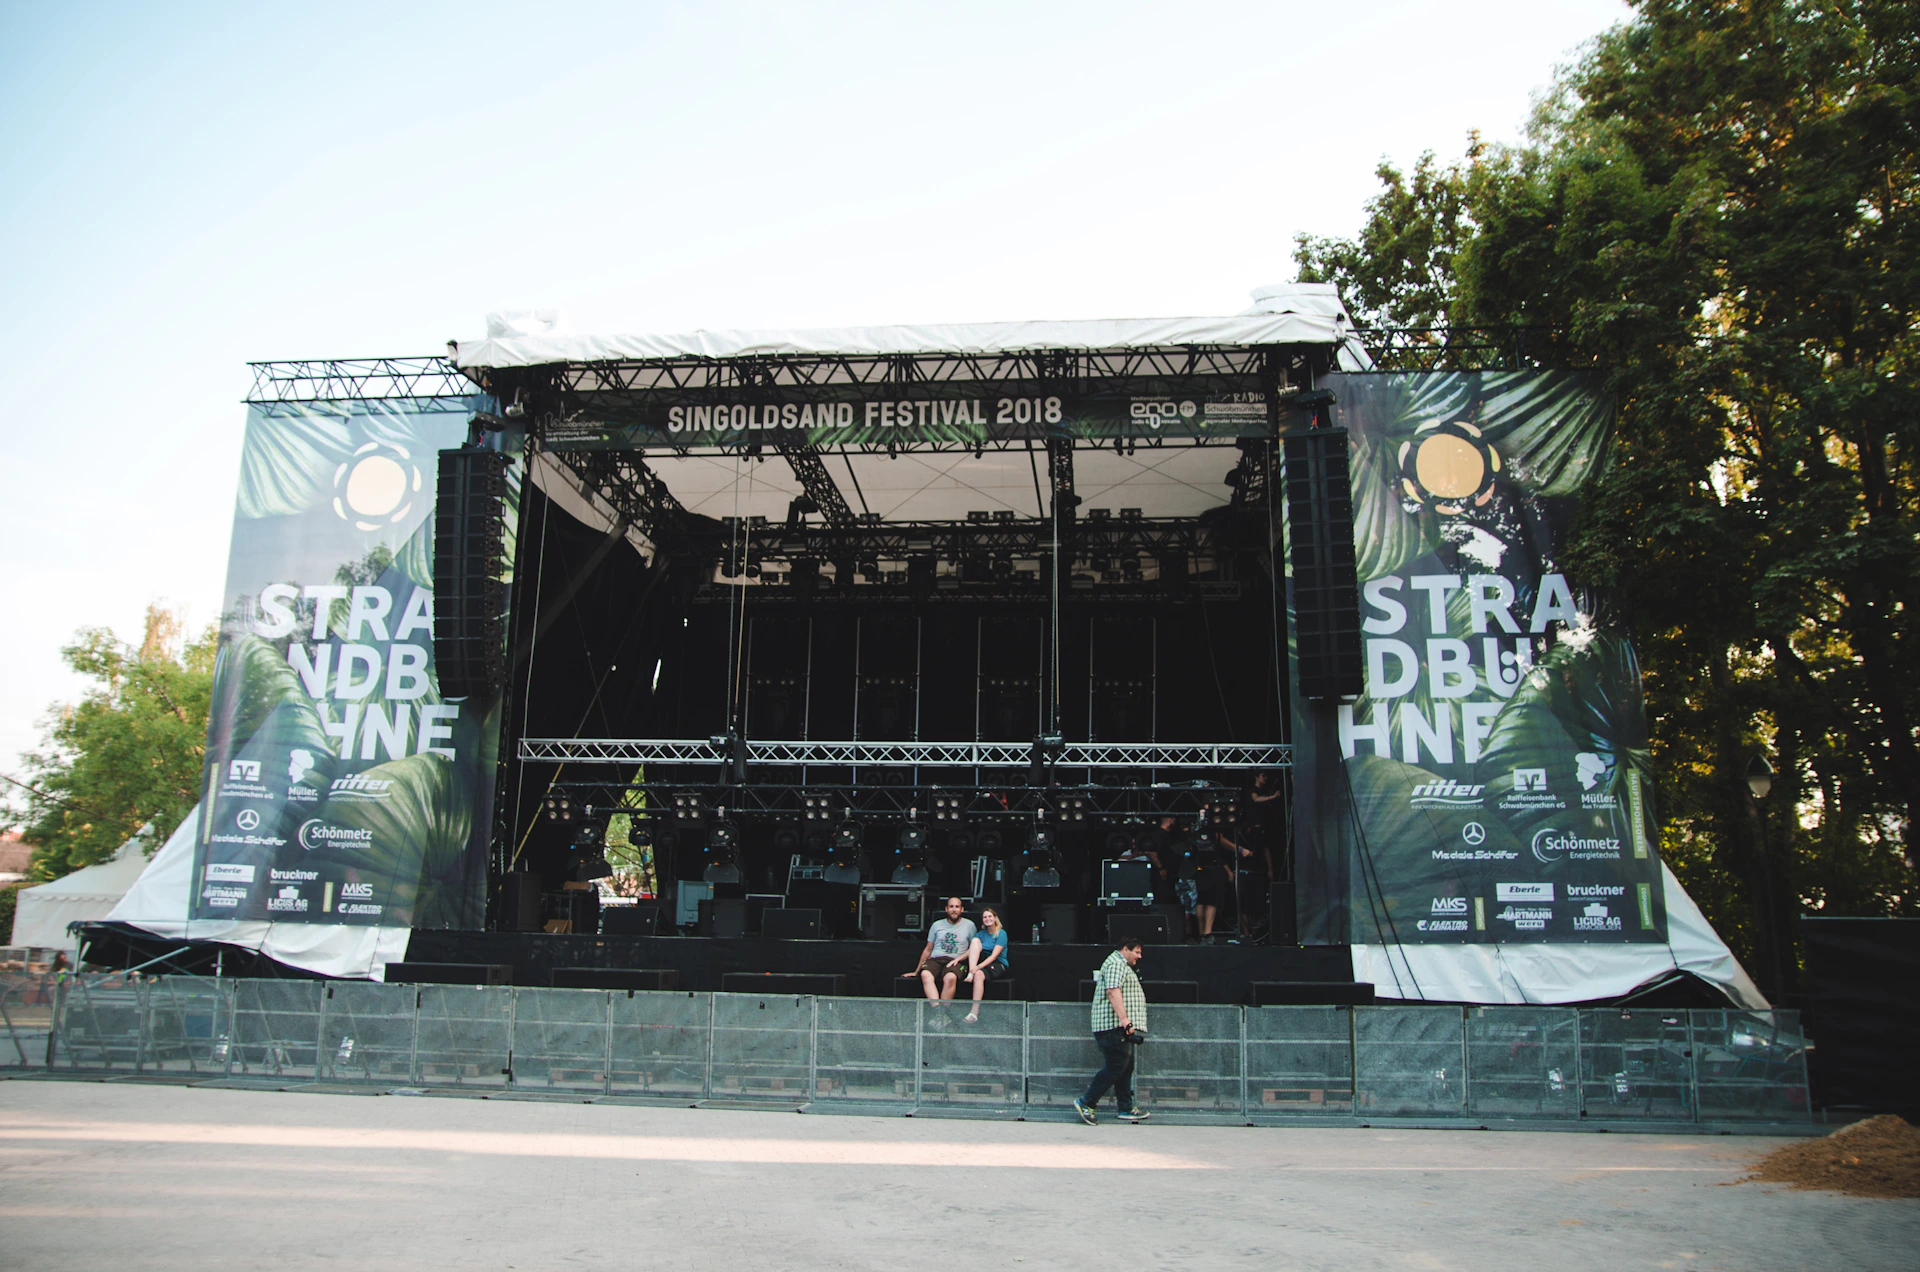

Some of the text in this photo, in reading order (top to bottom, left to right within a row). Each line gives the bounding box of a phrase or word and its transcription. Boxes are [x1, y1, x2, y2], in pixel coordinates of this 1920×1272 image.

[1233, 392, 1265, 403] RADIO
[668, 397, 1062, 432] SINGOLDSAND FESTIVAL 2018
[1361, 573, 1583, 634] STRA
[253, 583, 434, 641] STRA
[287, 643, 468, 701] NDB
[1411, 779, 1486, 796] ritter
[1581, 793, 1616, 803] Müller.
[1630, 773, 1645, 853] HAUPTSPONSOREN
[311, 826, 372, 840] Schönmetz
[1545, 836, 1620, 850] Schönmetz
[1570, 851, 1621, 861] Energietechnik
[270, 868, 318, 880] bruckner
[341, 882, 373, 897] MKS
[1509, 885, 1541, 893] Eberle
[1567, 883, 1625, 896] bruckner
[1431, 897, 1468, 912] MKS
[1504, 911, 1553, 920] HARTMANN
[1573, 916, 1621, 926] LICUS AG
